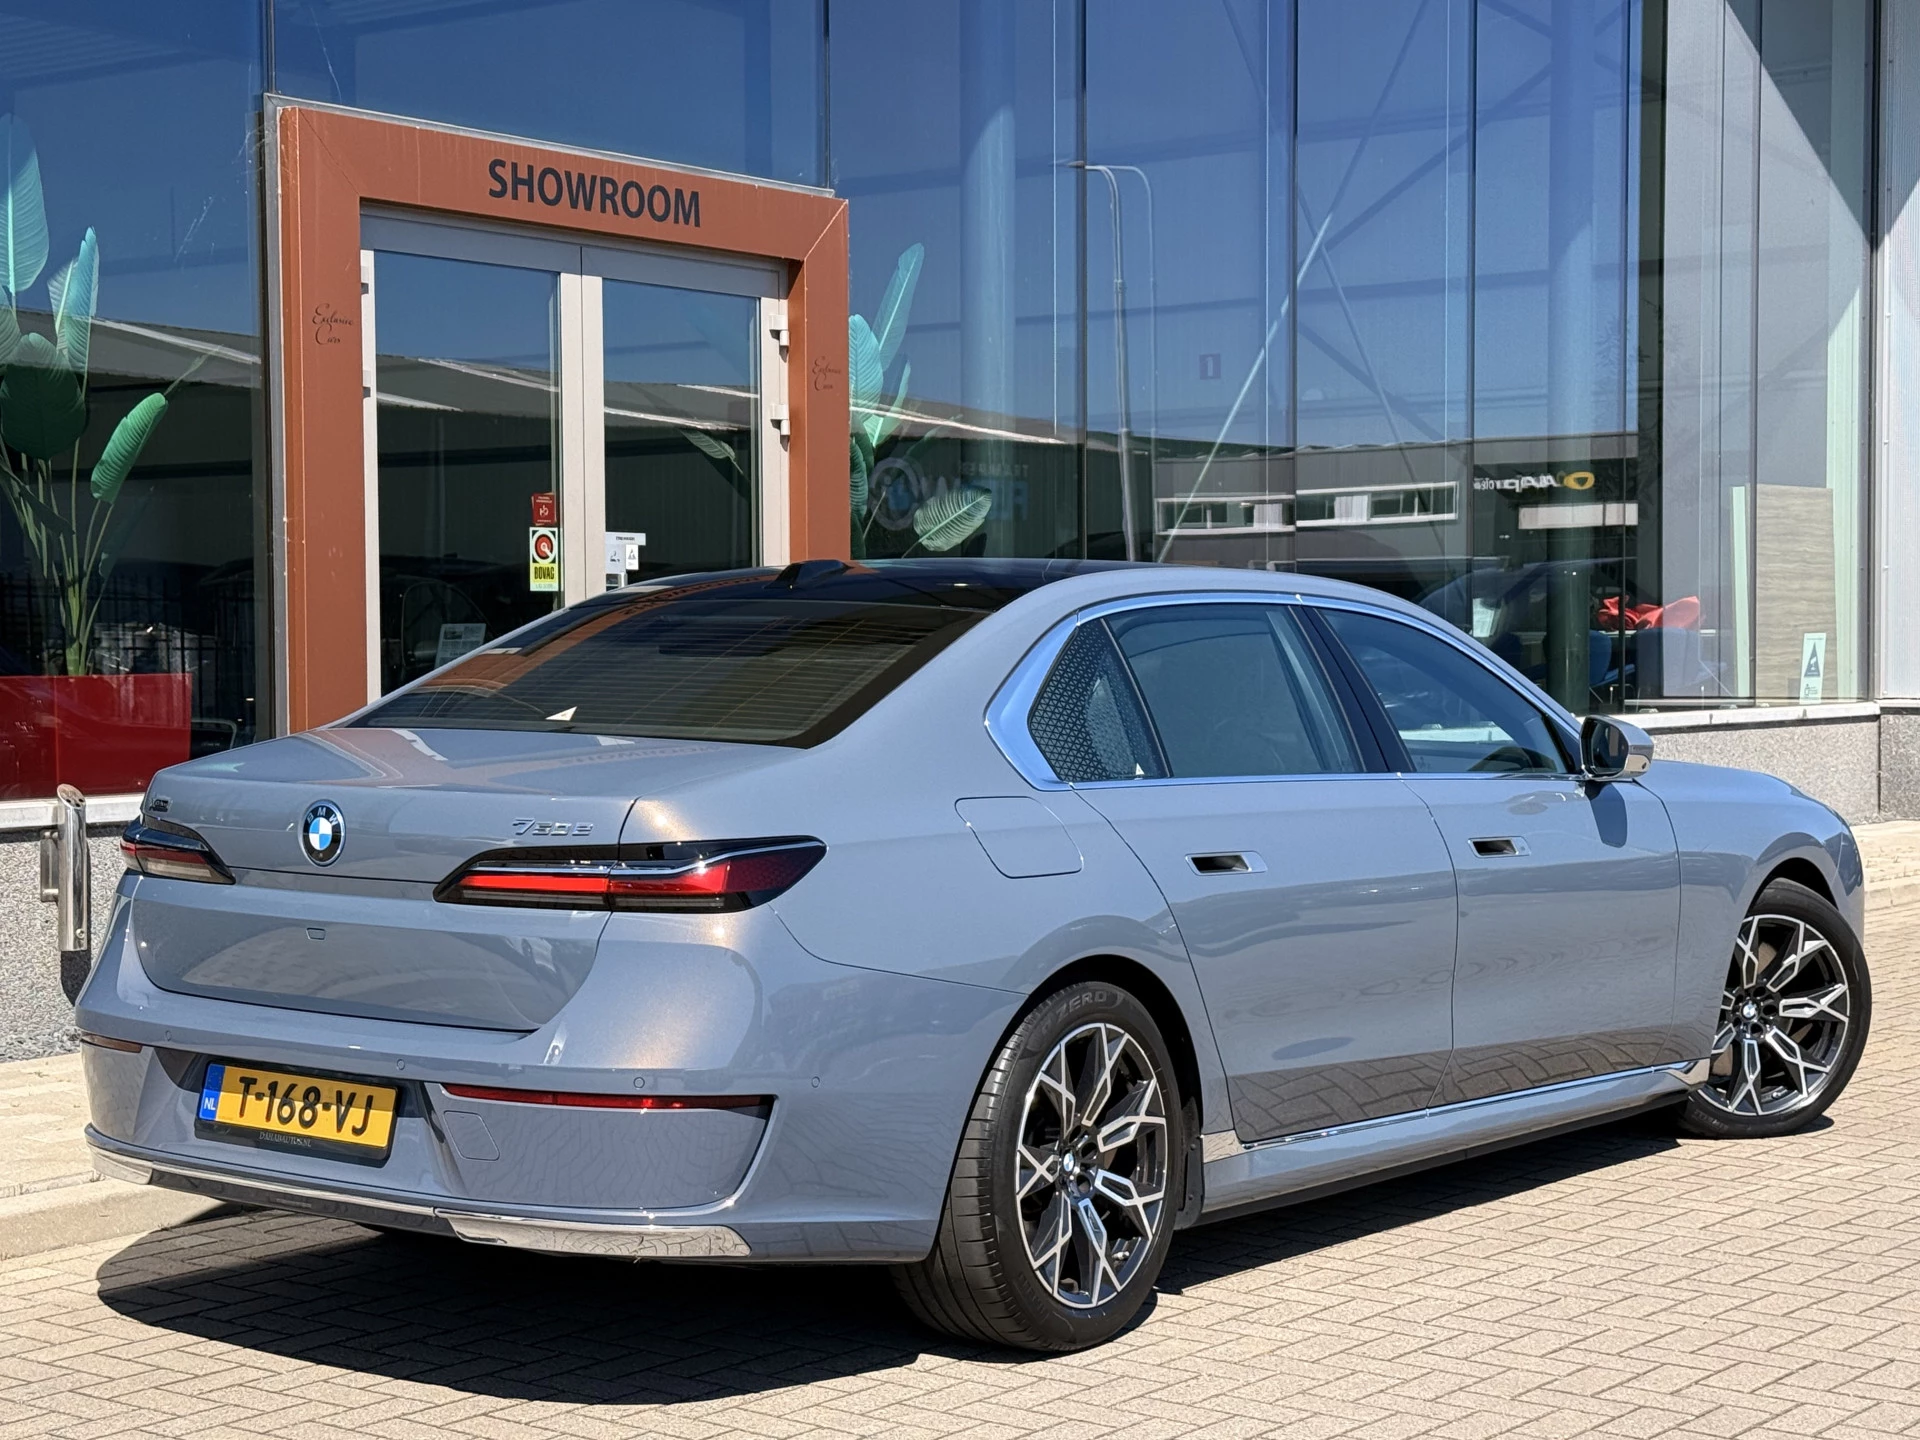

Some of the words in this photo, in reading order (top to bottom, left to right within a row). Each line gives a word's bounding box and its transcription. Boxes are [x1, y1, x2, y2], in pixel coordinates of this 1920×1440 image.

[488, 158, 701, 228] SHOWROOM
[534, 566, 555, 580] BOVAG
[306, 806, 339, 826] BMW
[1055, 990, 1108, 1021] ZERO
[203, 1096, 217, 1112] NL
[238, 1075, 375, 1137] T-168-VJ
